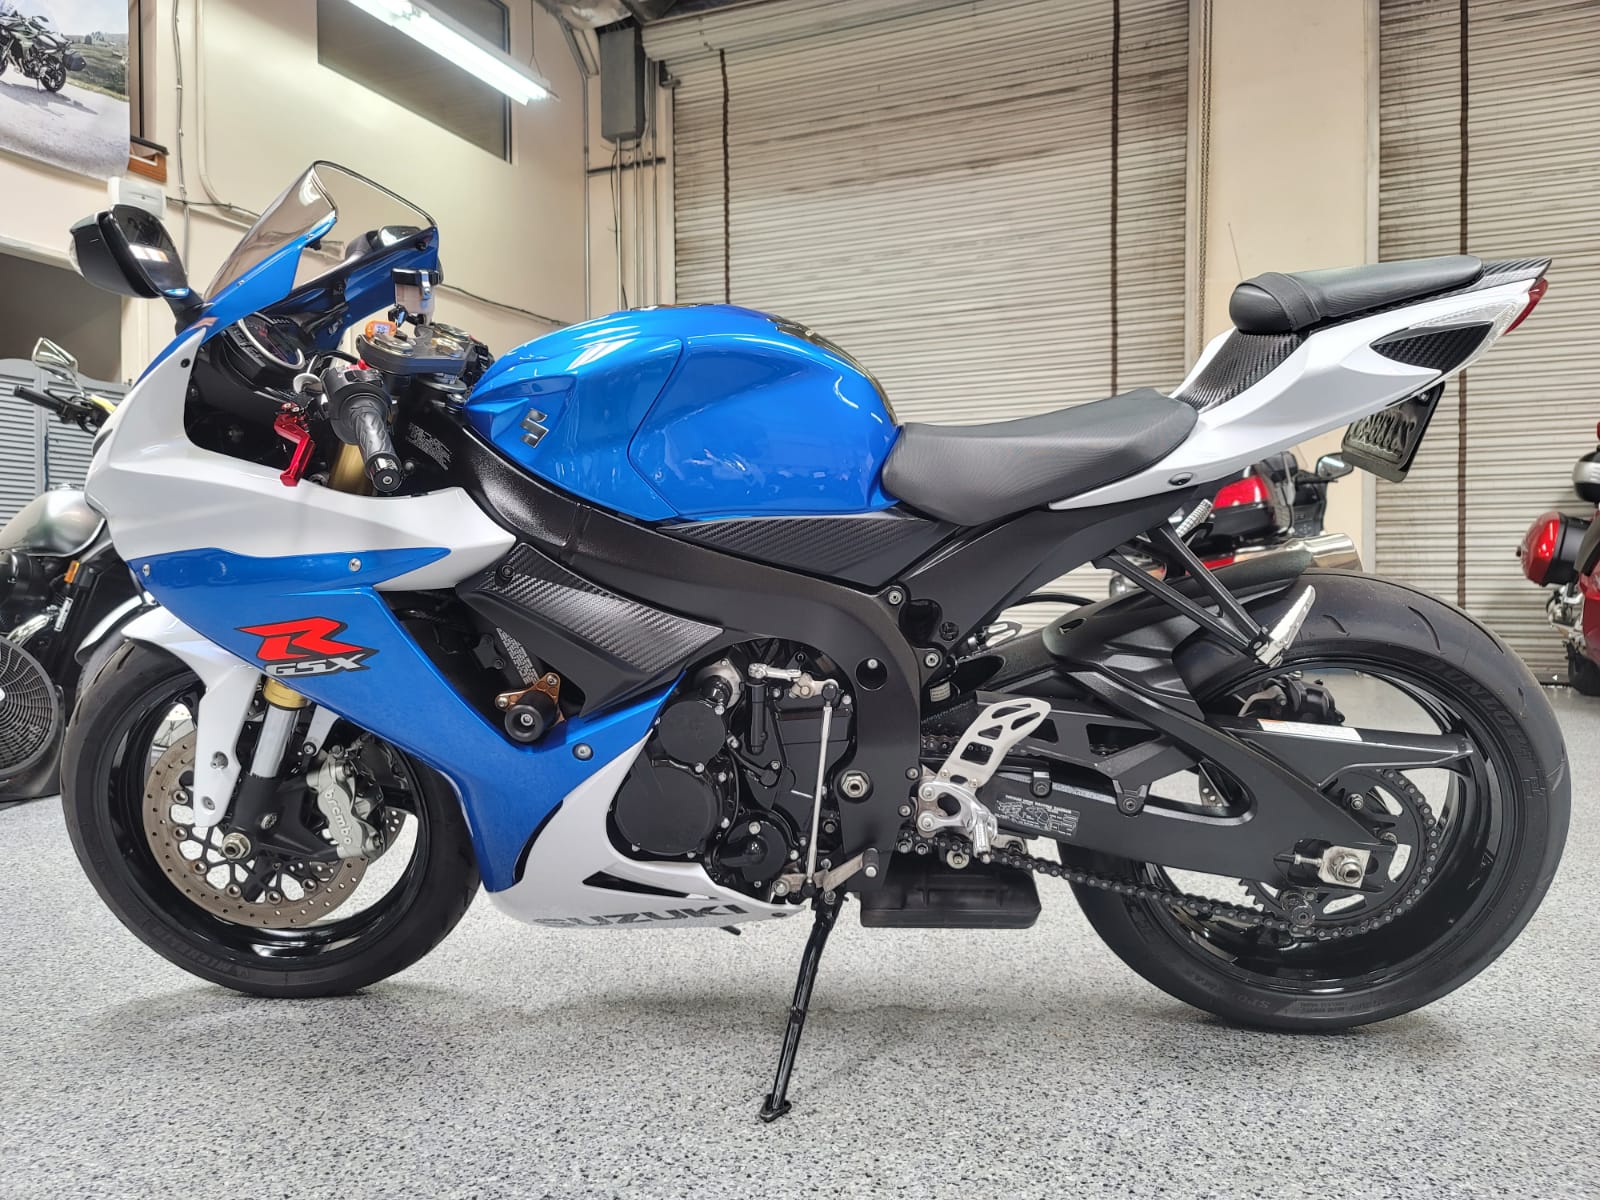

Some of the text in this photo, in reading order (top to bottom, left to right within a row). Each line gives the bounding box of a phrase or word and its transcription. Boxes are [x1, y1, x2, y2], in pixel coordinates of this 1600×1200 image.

[264, 653, 366, 677] GSX
[324, 788, 353, 846] brembo
[533, 904, 750, 928] SUZUKI
